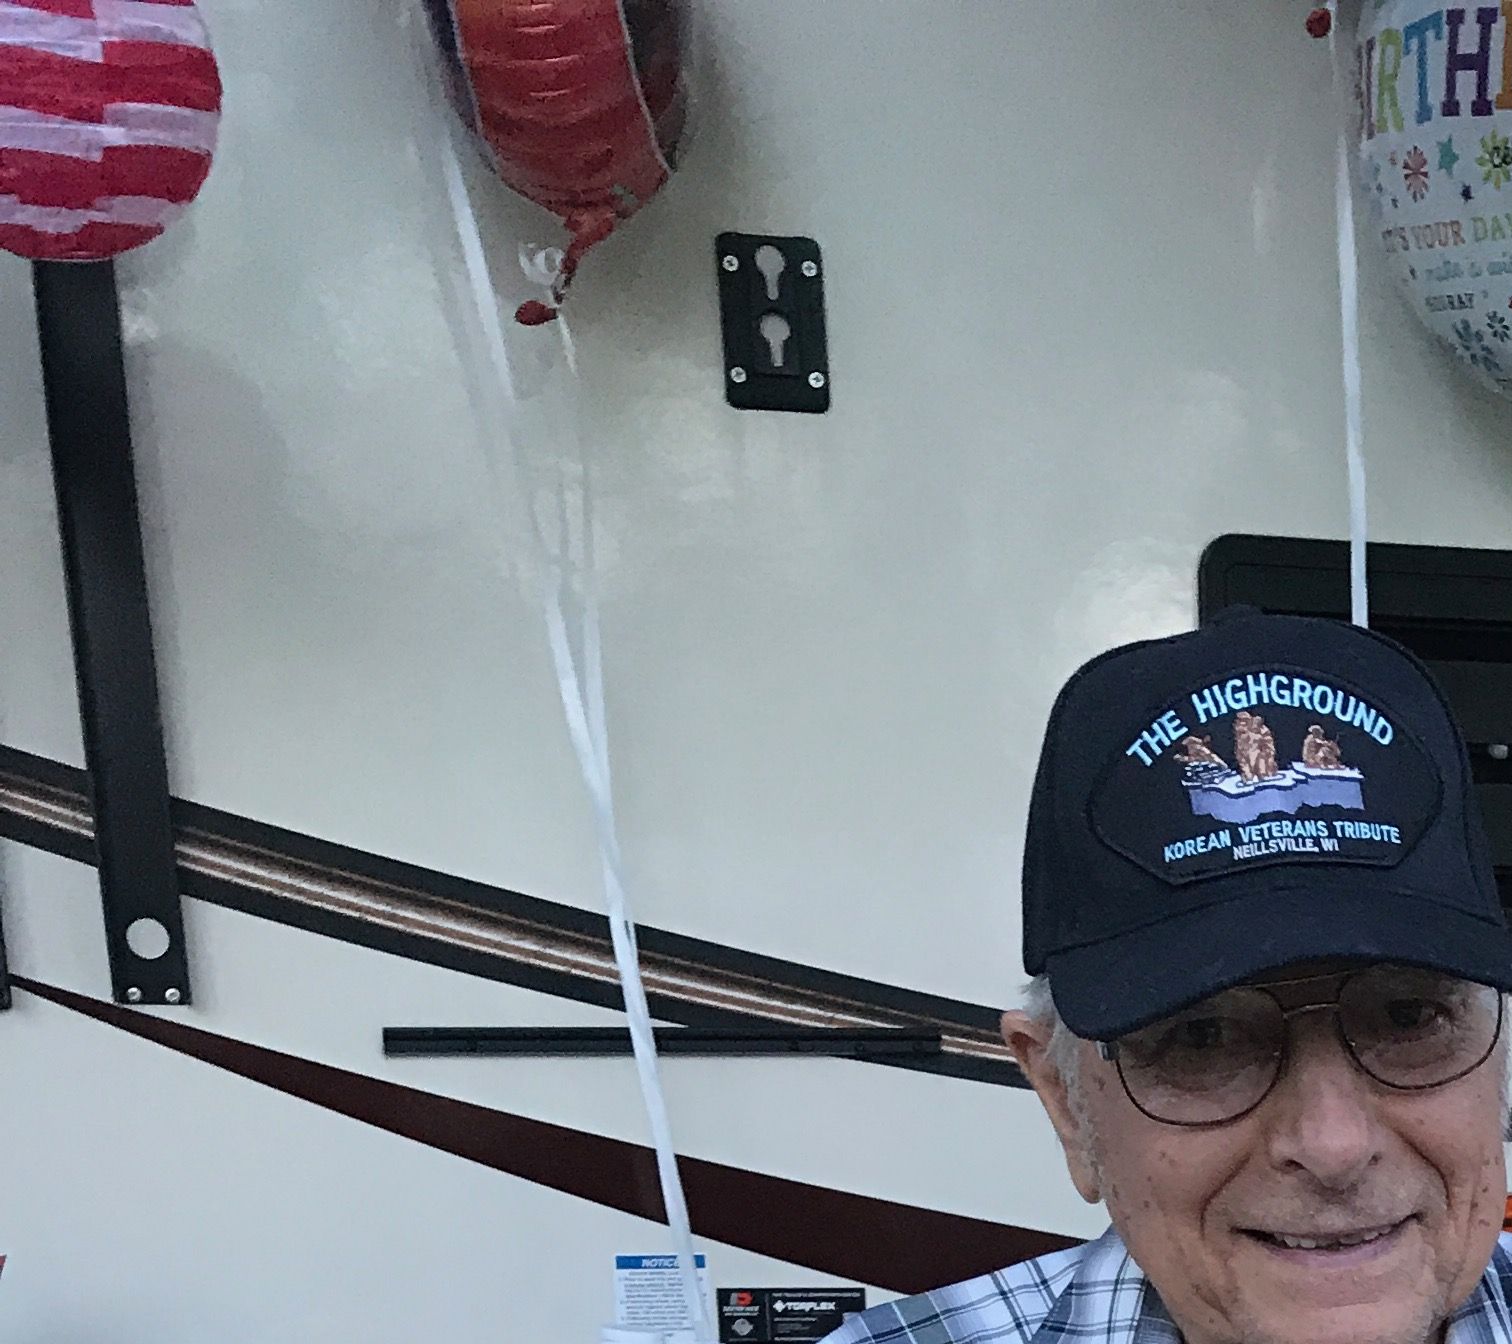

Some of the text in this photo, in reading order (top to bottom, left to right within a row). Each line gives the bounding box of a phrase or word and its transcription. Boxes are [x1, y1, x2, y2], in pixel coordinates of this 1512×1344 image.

[1126, 672, 1395, 767] THE HIGHGROUND
[1163, 820, 1402, 863] KOREAN VETERANS TRIBUTE
[1321, 838, 1340, 852] WI
